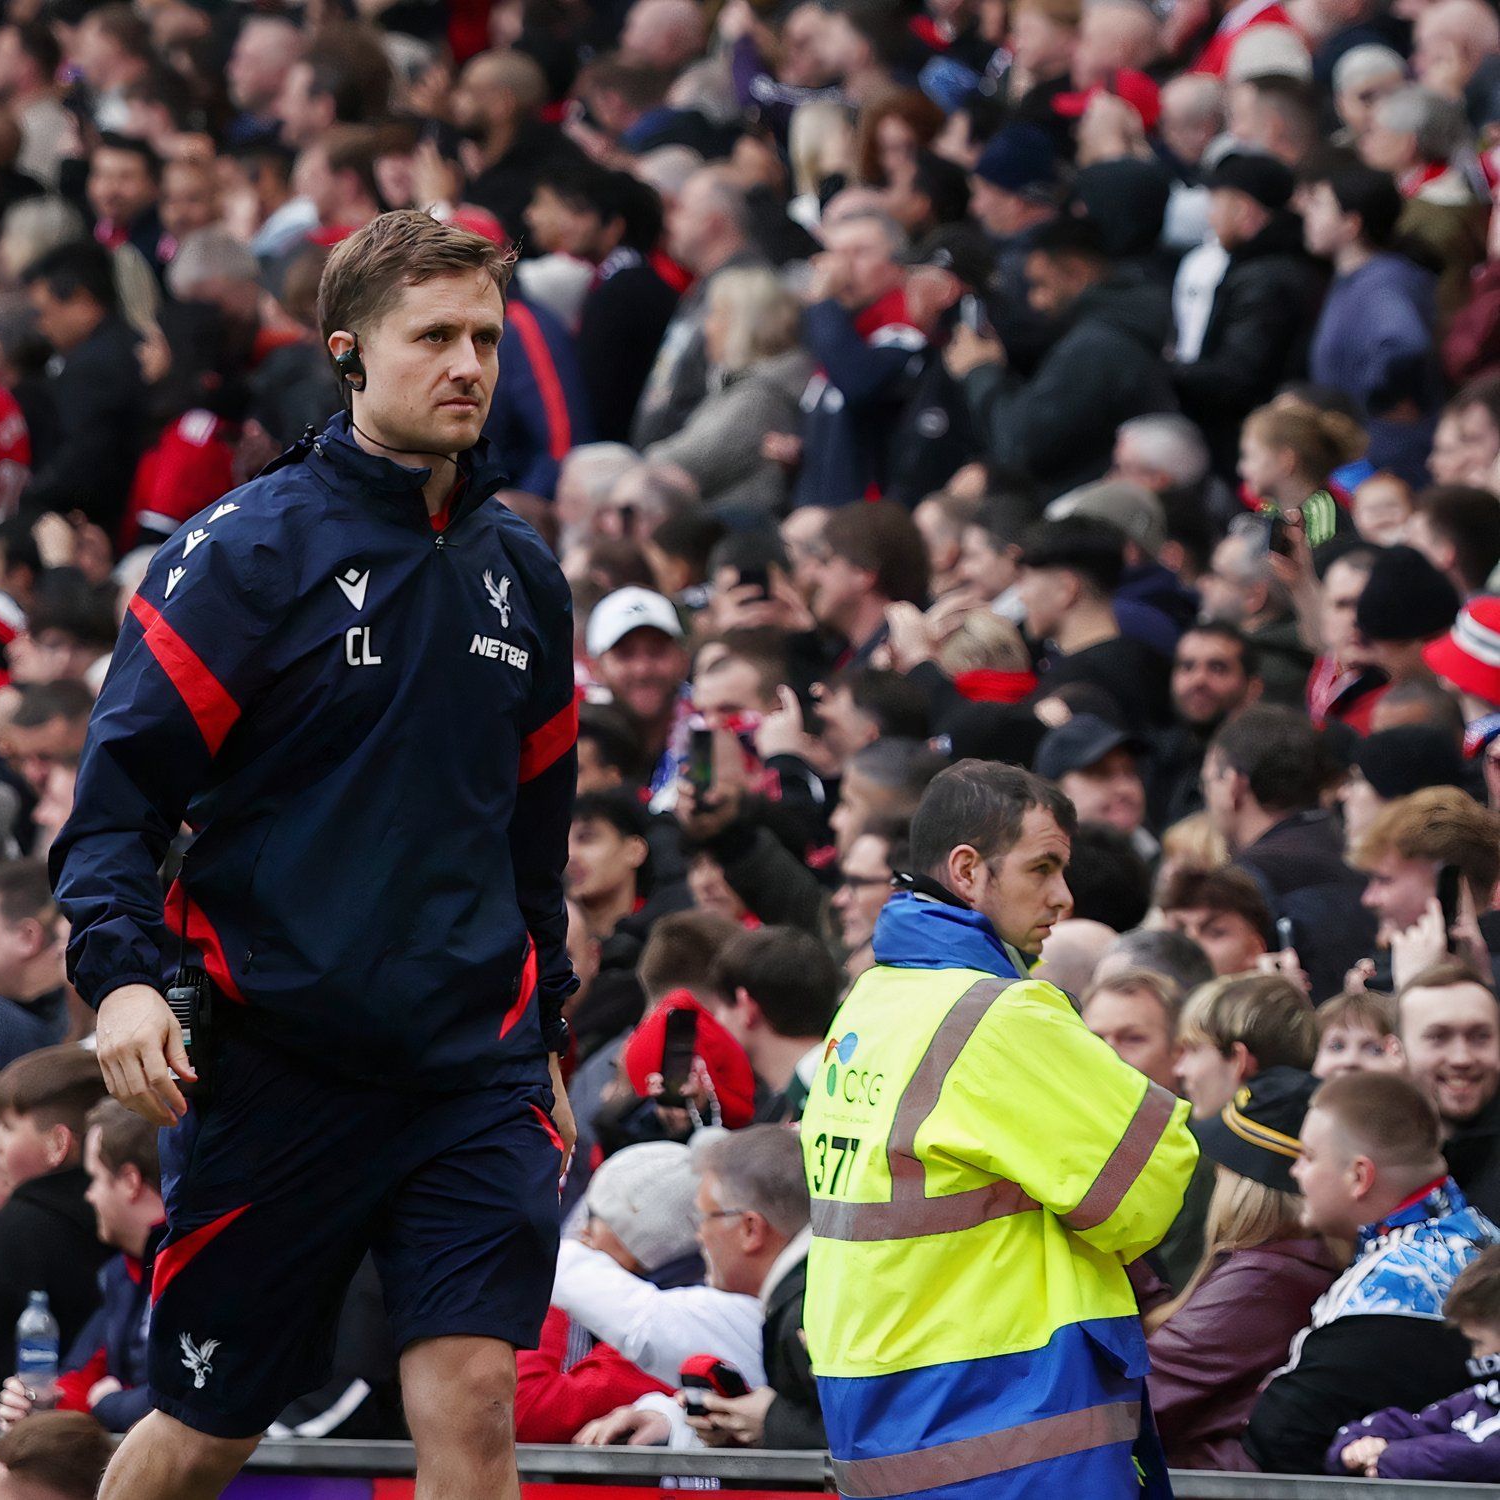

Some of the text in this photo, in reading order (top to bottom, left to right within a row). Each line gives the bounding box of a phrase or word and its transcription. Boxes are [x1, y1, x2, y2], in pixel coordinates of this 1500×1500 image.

[346, 626, 382, 666] CL
[469, 634, 529, 671] NET88
[843, 1069, 884, 1106] CSG
[814, 1133, 860, 1196] 377
